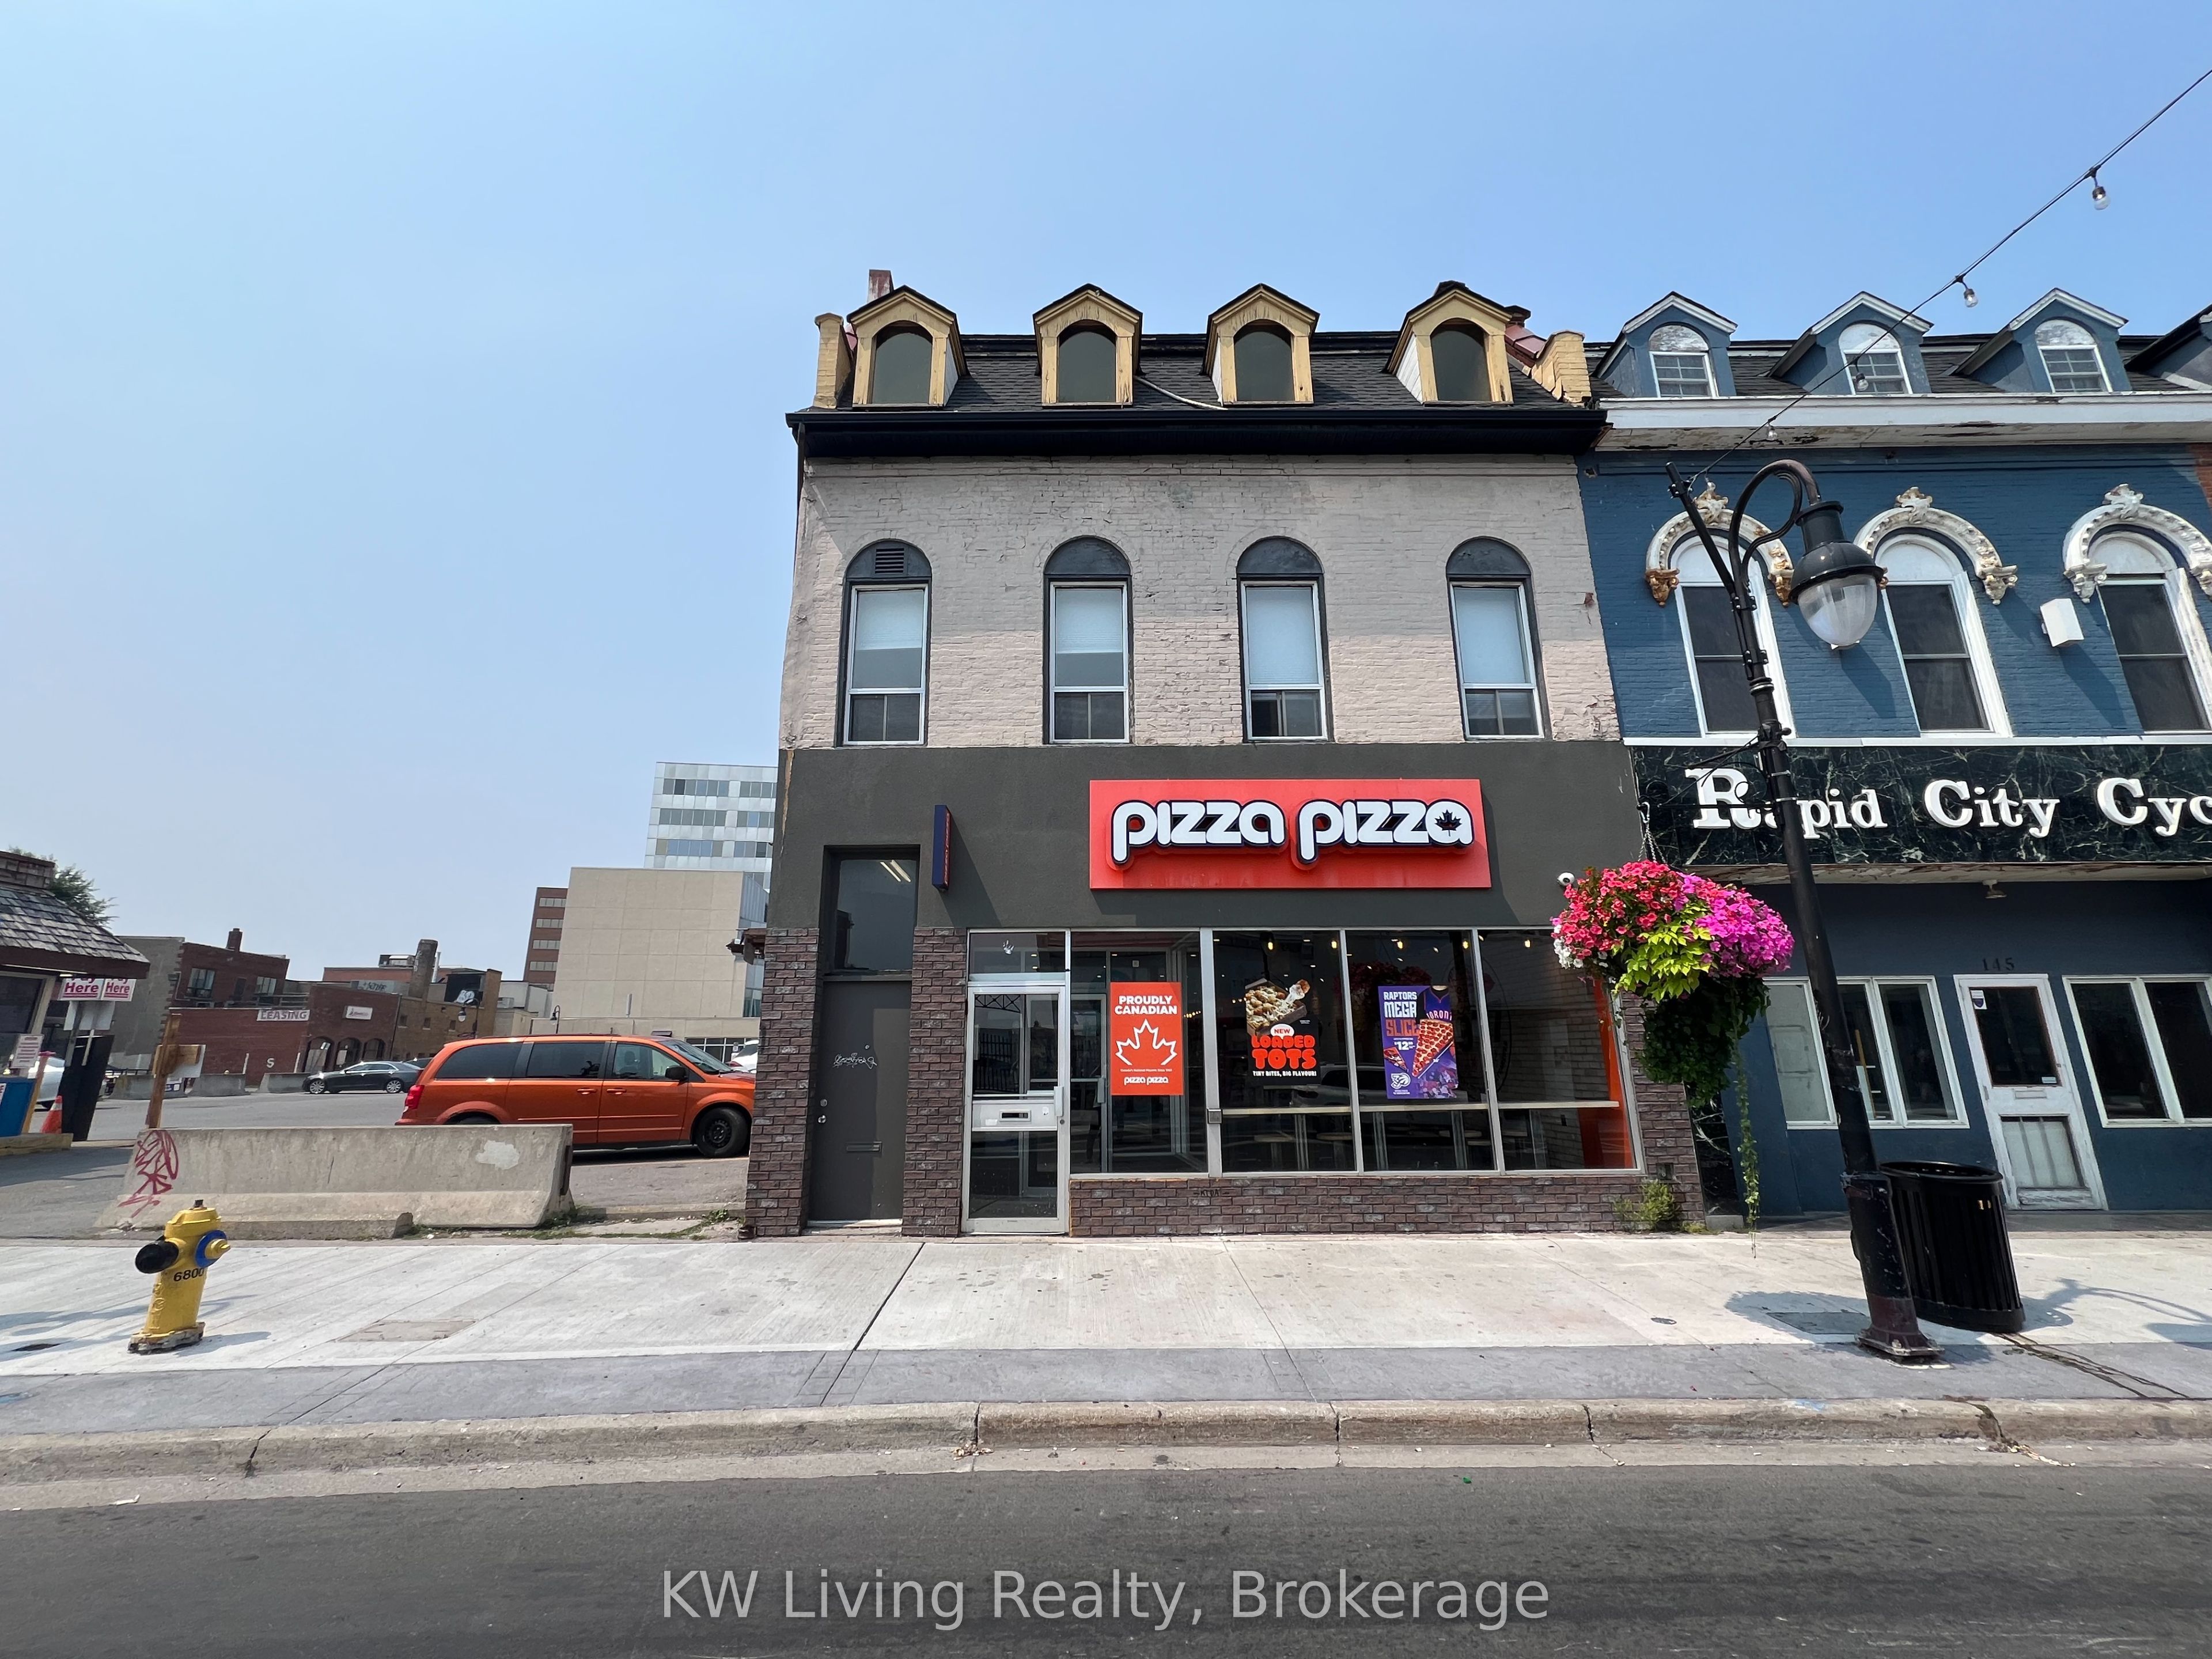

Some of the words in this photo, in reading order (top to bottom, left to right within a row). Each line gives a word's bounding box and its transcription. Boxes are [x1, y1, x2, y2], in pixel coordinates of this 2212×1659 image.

[1685, 768, 1887, 839] Rpid
[1925, 779, 2059, 838] City
[2096, 778, 2212, 838] Cyc
[1111, 800, 1286, 864] pizza
[1297, 799, 1474, 864] pizza
[1982, 957, 2014, 971] 145
[65, 982, 99, 993] Here
[105, 982, 130, 993] Here
[1119, 995, 1172, 1005] PROUDLY
[1384, 991, 1417, 1000] RAPTORS
[260, 1010, 307, 1020] LEASING
[1114, 1006, 1177, 1014] CANADIAN
[1384, 1001, 1417, 1018] MEGA
[1385, 1019, 1419, 1036] SLICE
[1251, 1035, 1315, 1048] LOADED
[1252, 1048, 1317, 1070] TOTS
[1124, 1077, 1146, 1086] pizza
[1146, 1077, 1169, 1086] pizza
[174, 1268, 204, 1282] 6800
